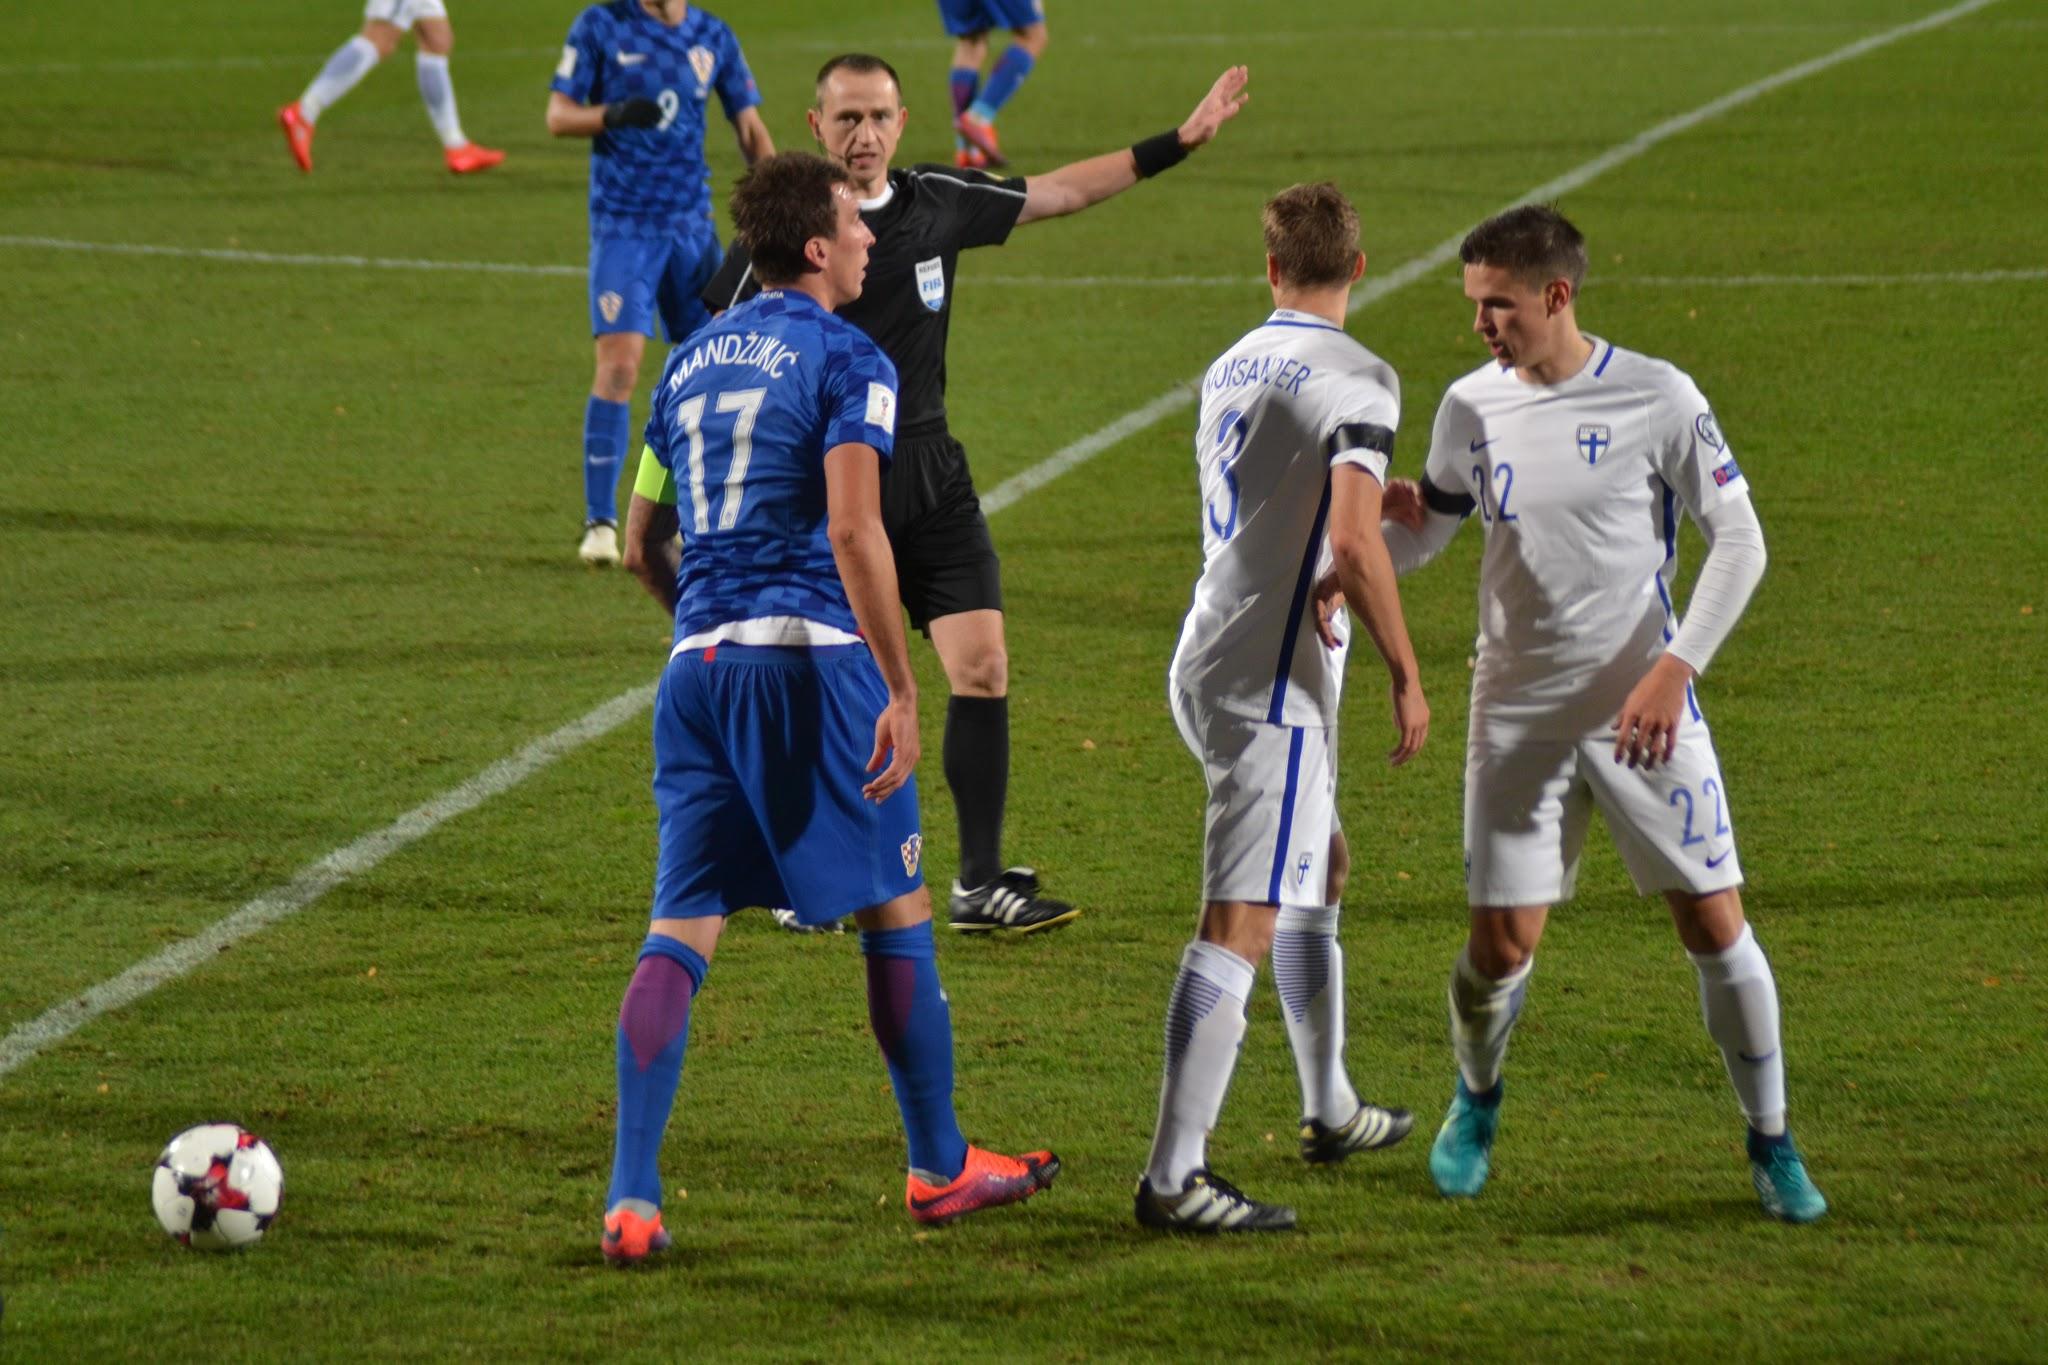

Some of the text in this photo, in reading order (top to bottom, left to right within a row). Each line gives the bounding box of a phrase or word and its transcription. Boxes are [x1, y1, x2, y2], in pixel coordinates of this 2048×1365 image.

[670, 330, 800, 393] MANDŽUKIĆ
[677, 387, 768, 534] 17
[1209, 408, 1248, 542] 3
[1471, 463, 1518, 522] 22
[1669, 777, 1729, 846] 22
